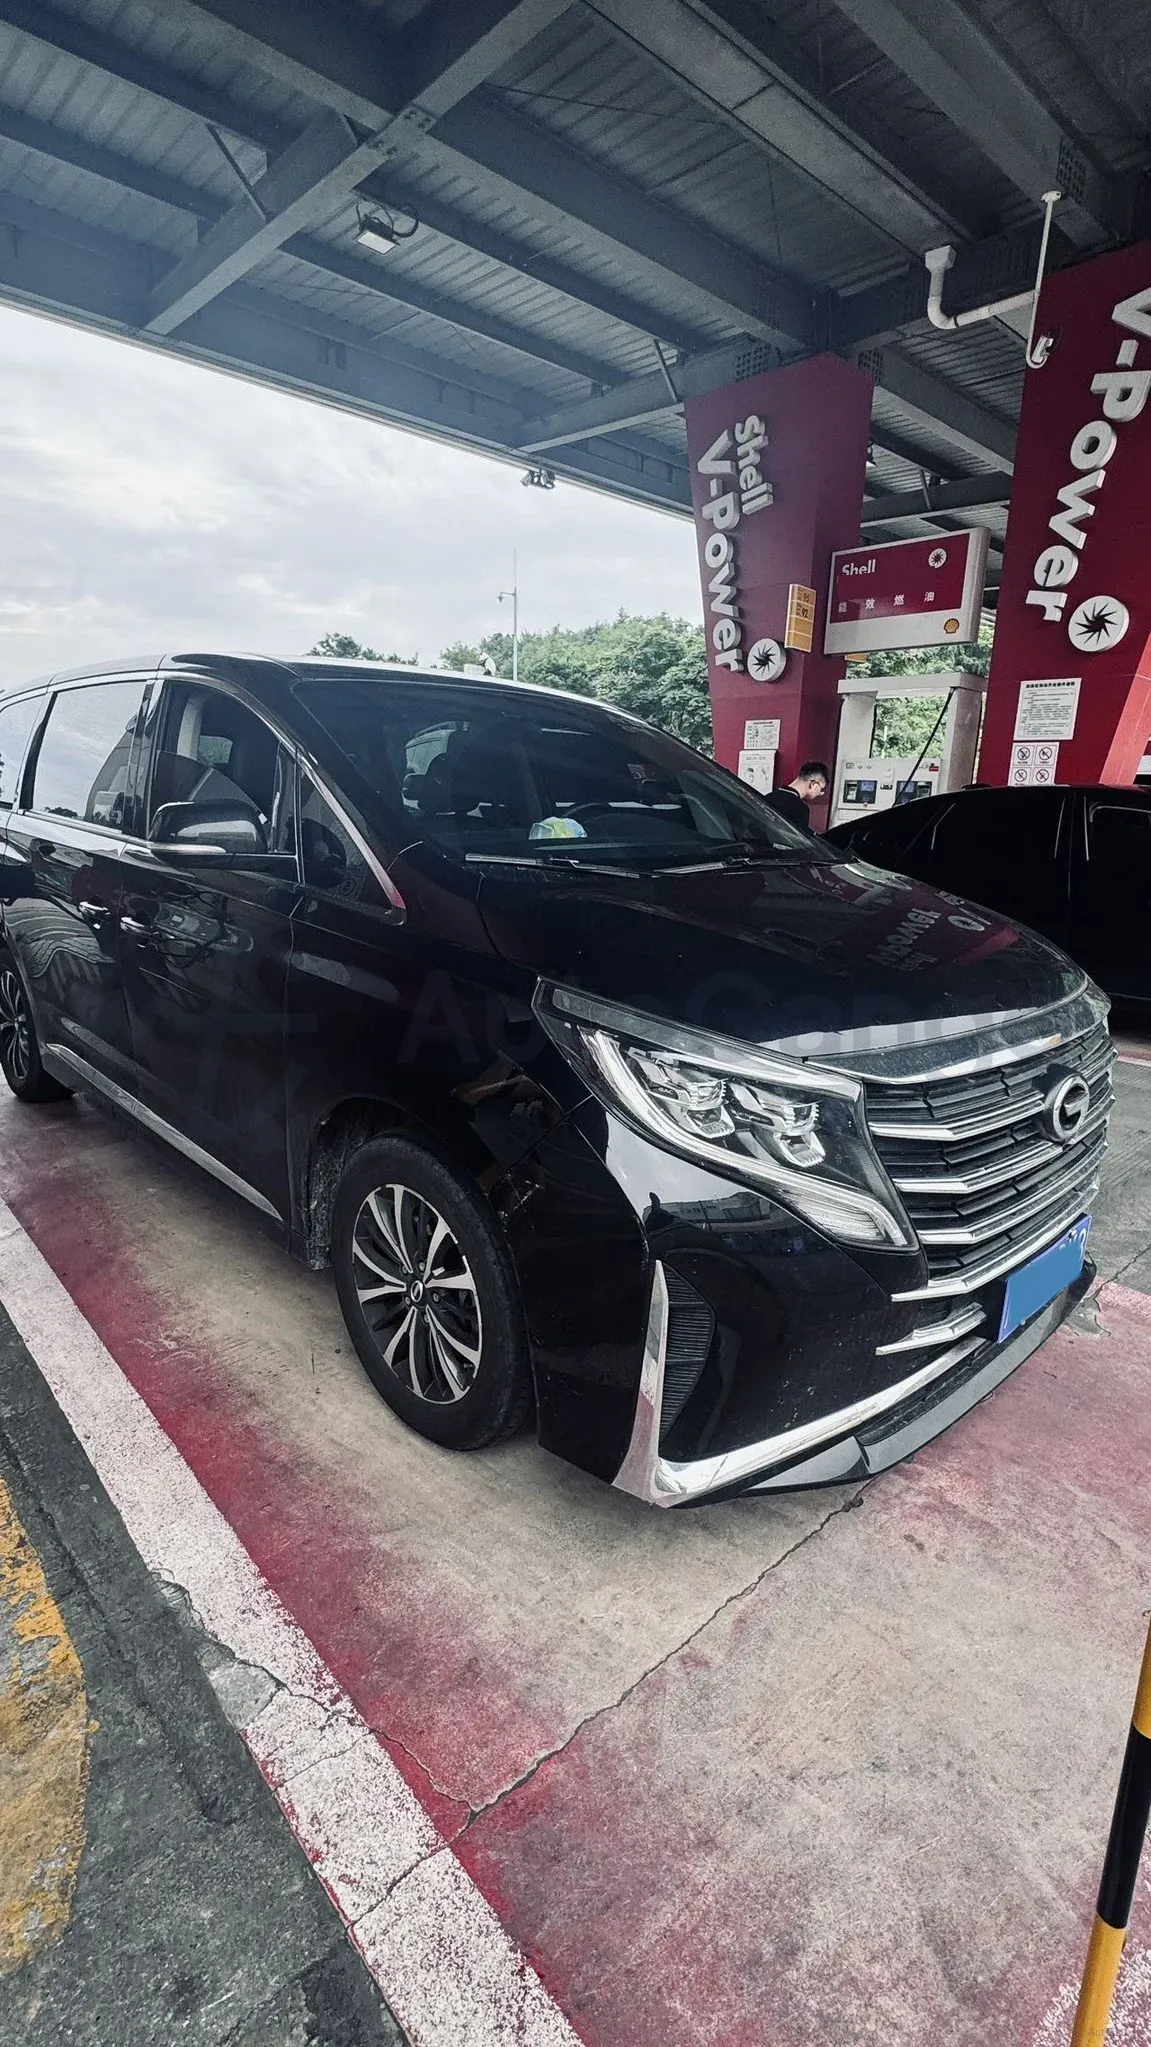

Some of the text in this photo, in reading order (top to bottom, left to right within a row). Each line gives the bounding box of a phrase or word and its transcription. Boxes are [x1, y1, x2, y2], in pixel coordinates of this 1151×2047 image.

[735, 415, 774, 515] Shell
[1025, 286, 1151, 622] V-Power
[698, 429, 744, 672] V-Power
[842, 559, 876, 575] Shell
